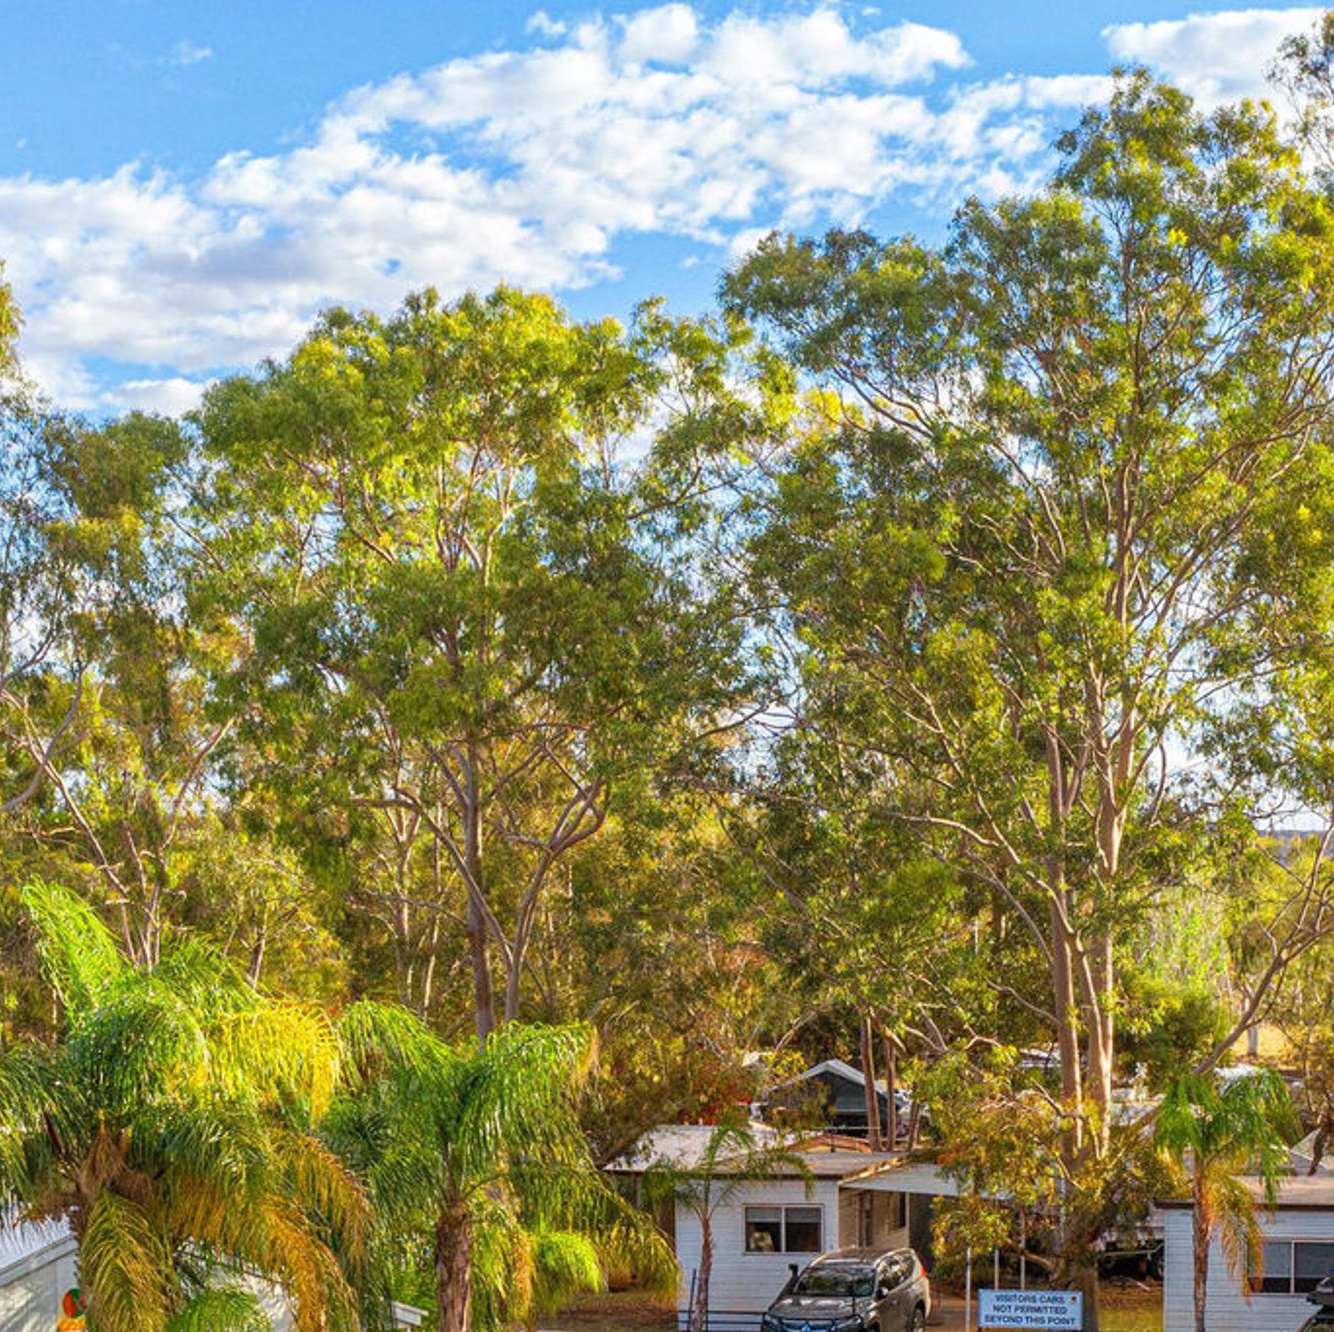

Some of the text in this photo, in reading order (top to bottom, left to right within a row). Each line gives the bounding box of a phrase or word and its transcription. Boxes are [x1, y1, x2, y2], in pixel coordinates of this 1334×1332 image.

[994, 1294, 1037, 1303] VISITORS
[992, 1304, 1068, 1315] NOT PERMITTED
[985, 1314, 1075, 1325] BEYOND THIS POINT
